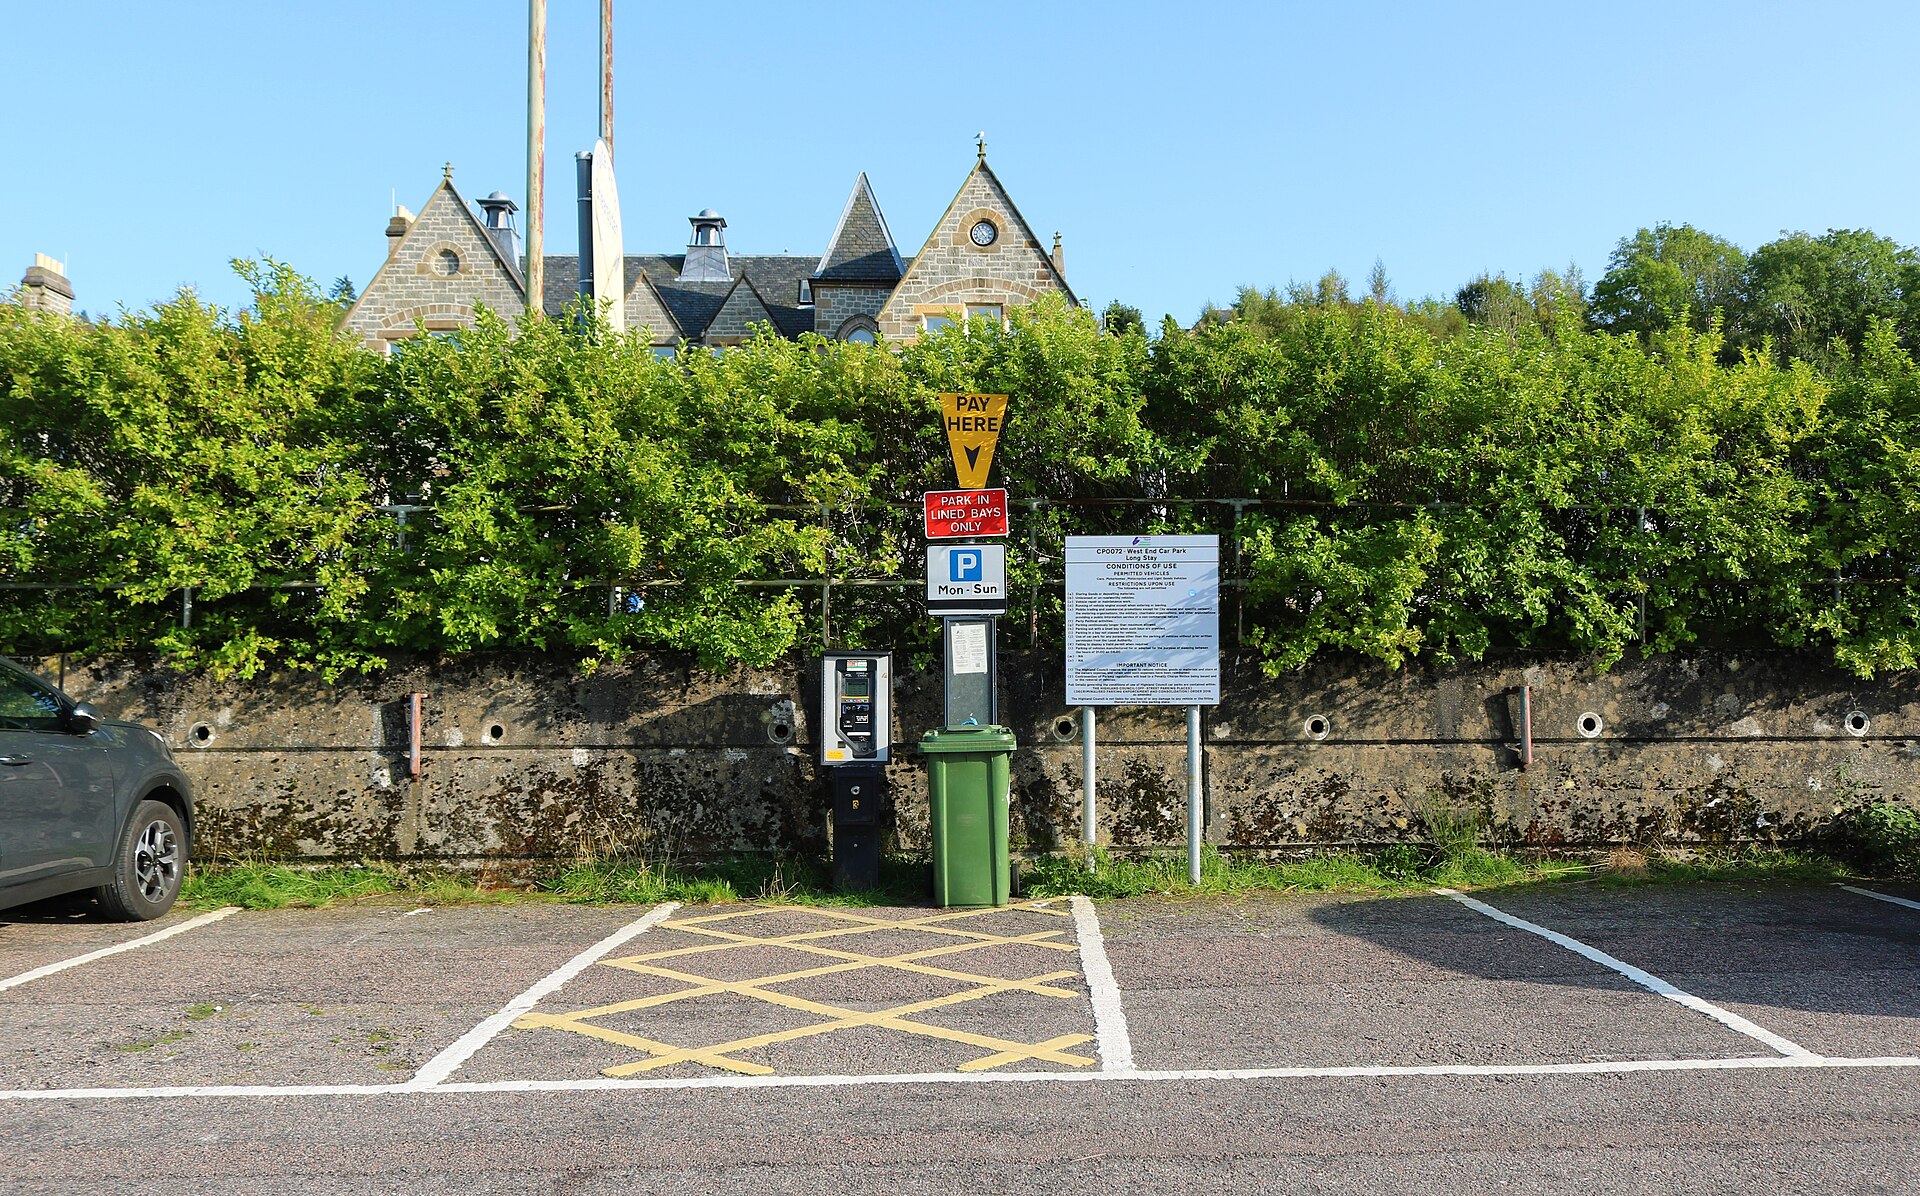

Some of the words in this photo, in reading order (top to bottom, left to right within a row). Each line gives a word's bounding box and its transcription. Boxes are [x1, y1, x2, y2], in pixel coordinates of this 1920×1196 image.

[956, 396, 991, 412] PAY
[948, 417, 999, 432] HERE
[941, 495, 972, 506] PARK
[977, 494, 990, 505] IN
[931, 508, 966, 521] LINED
[971, 507, 1001, 518] BAYS
[950, 521, 982, 533] ONLY
[957, 553, 977, 579] P
[938, 584, 964, 595] Mon
[973, 583, 997, 594] Sun
